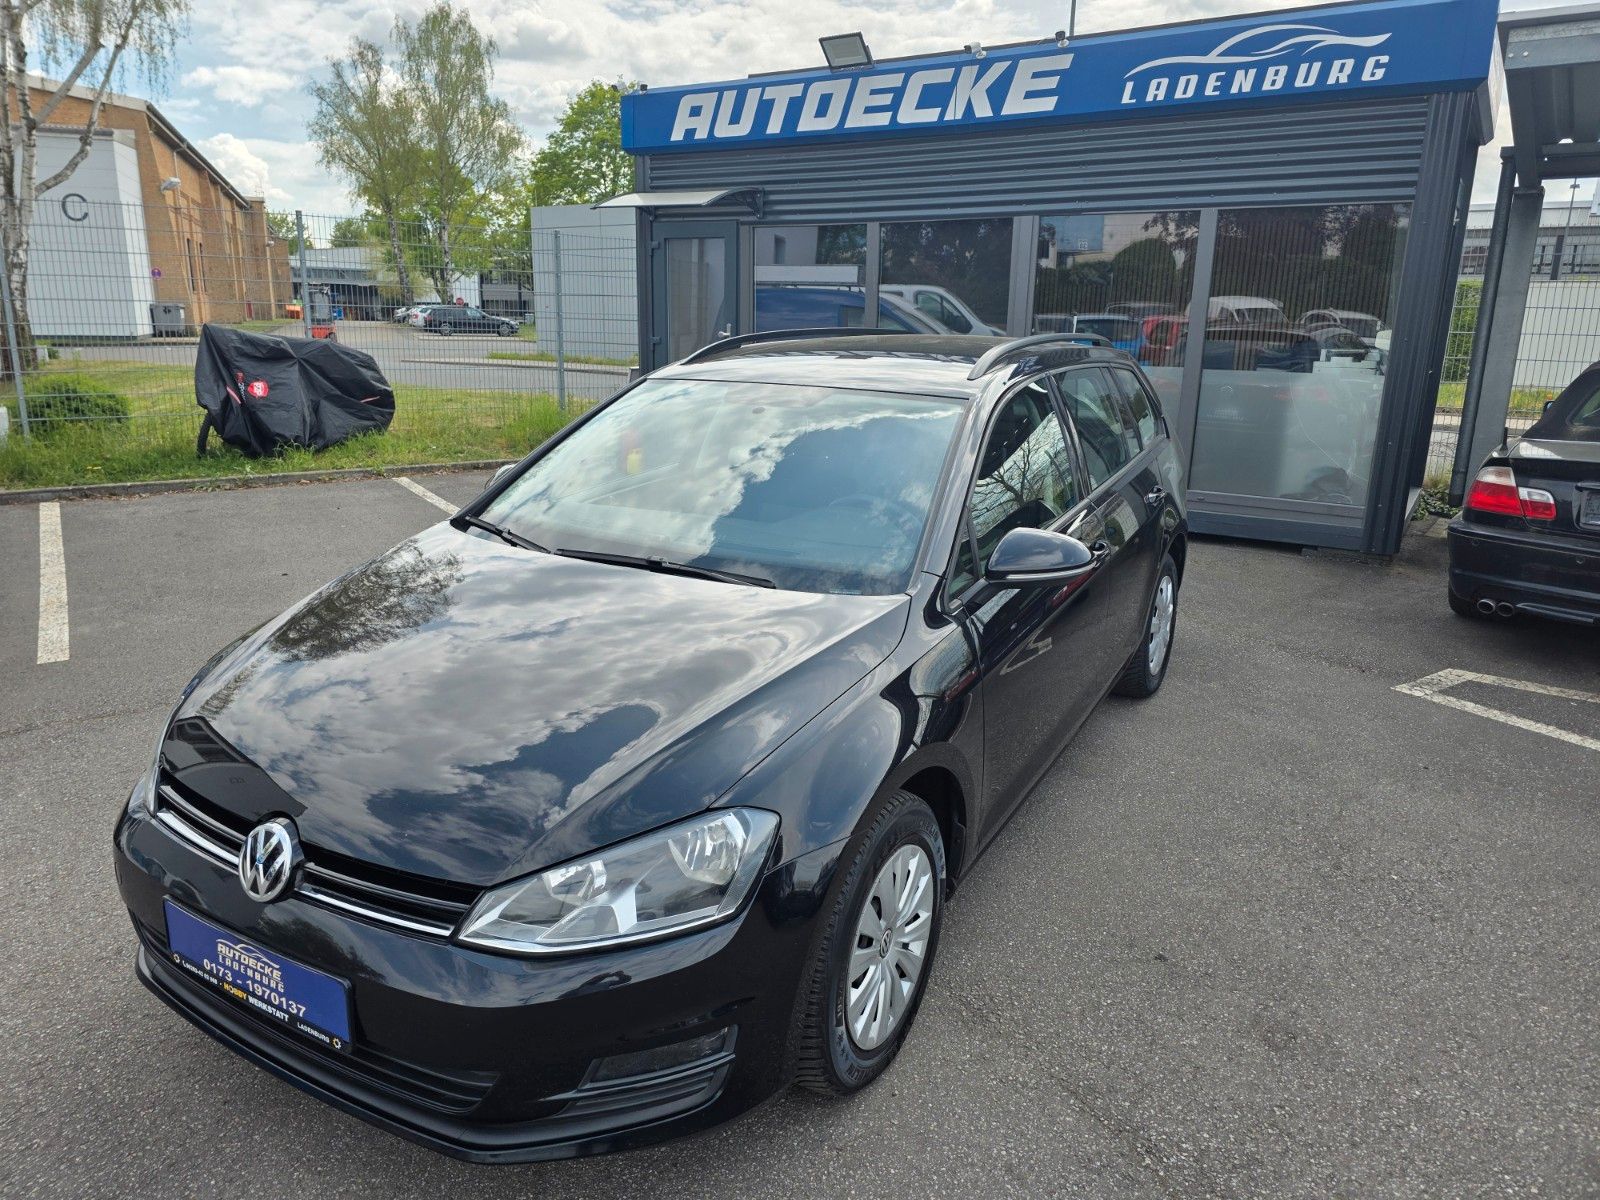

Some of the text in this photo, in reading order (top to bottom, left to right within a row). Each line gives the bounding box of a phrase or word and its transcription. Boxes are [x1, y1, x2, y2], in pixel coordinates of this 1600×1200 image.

[671, 53, 1074, 142] AUTOECKE
[1121, 54, 1390, 105] LADENBURG
[61, 193, 88, 221] C
[217, 943, 282, 981] AUTOECKE
[218, 955, 285, 993] LADENBURG
[203, 958, 233, 982] 0173
[246, 980, 306, 1017] 1970137
[224, 981, 247, 1000] HOBBY
[247, 994, 289, 1022] WERKSTATT
